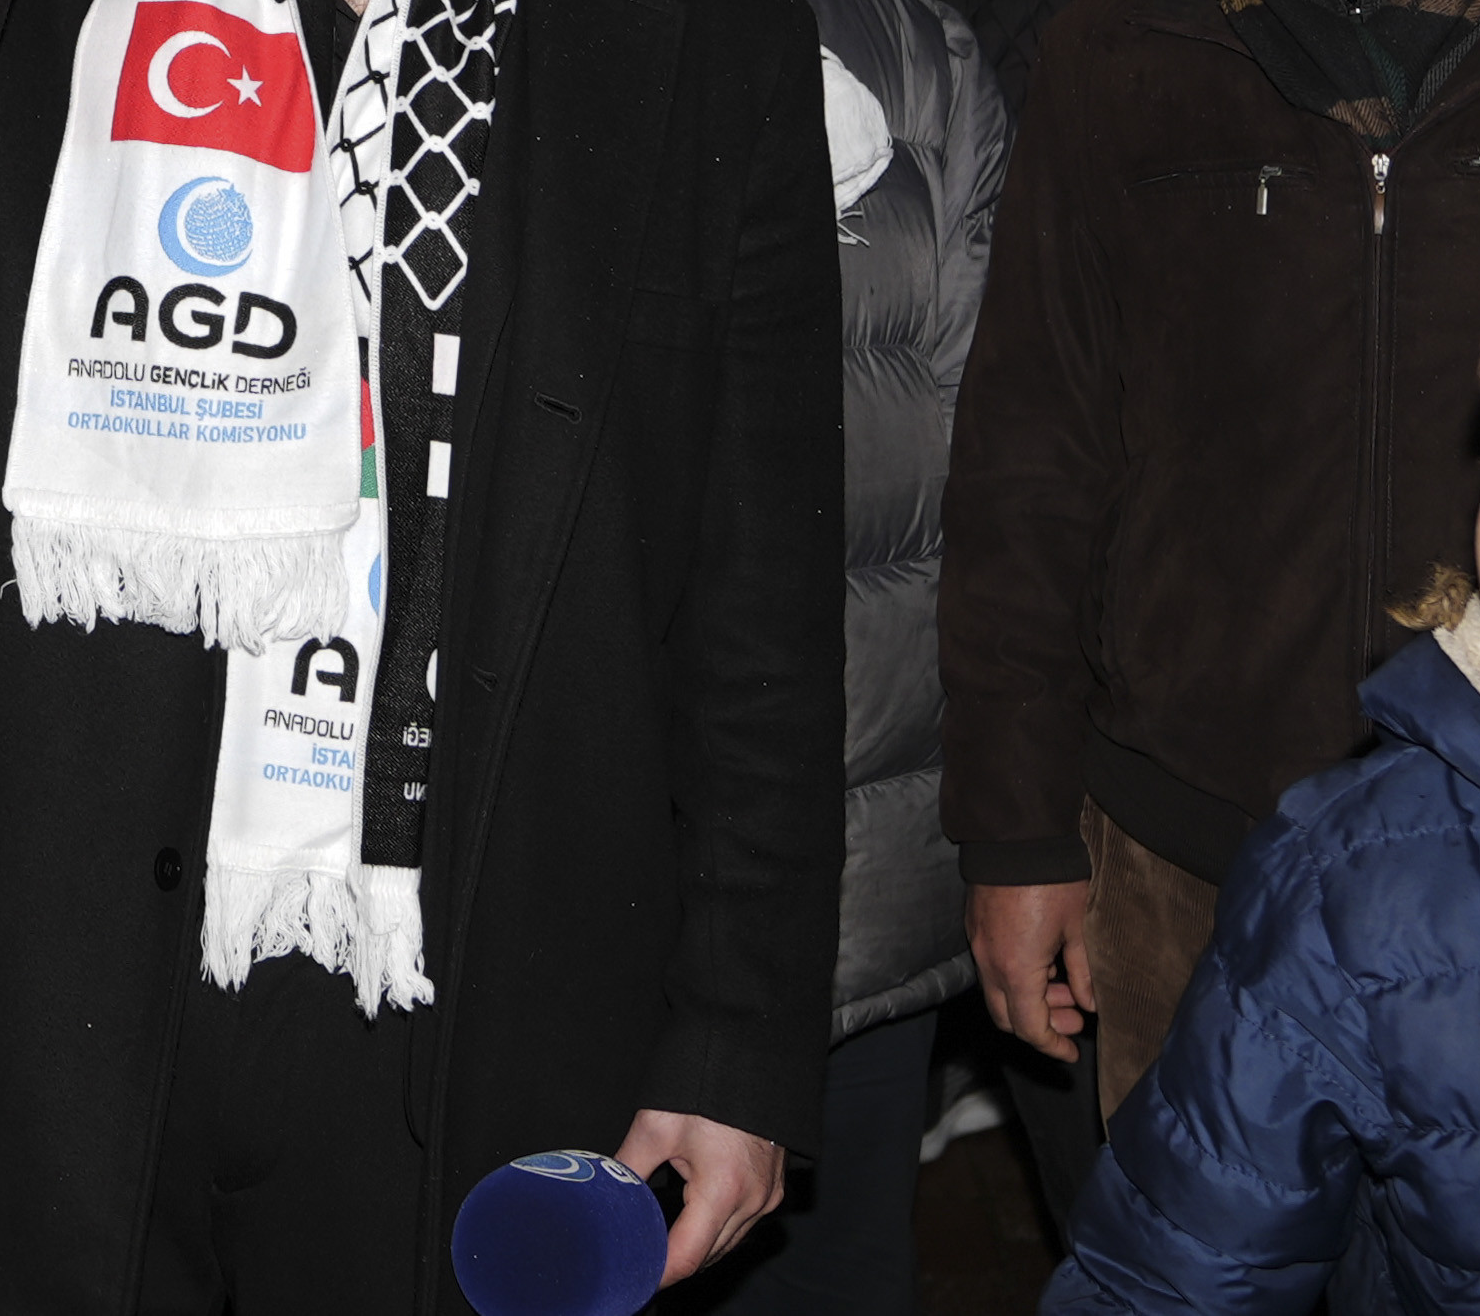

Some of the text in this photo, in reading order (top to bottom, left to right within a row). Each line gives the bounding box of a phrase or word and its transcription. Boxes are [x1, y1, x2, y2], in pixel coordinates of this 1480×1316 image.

[89, 275, 298, 360] AGD
[67, 357, 146, 382] ANADOLU
[67, 411, 190, 441] ORTAOKULLAR
[263, 708, 355, 741] ANADOLU
